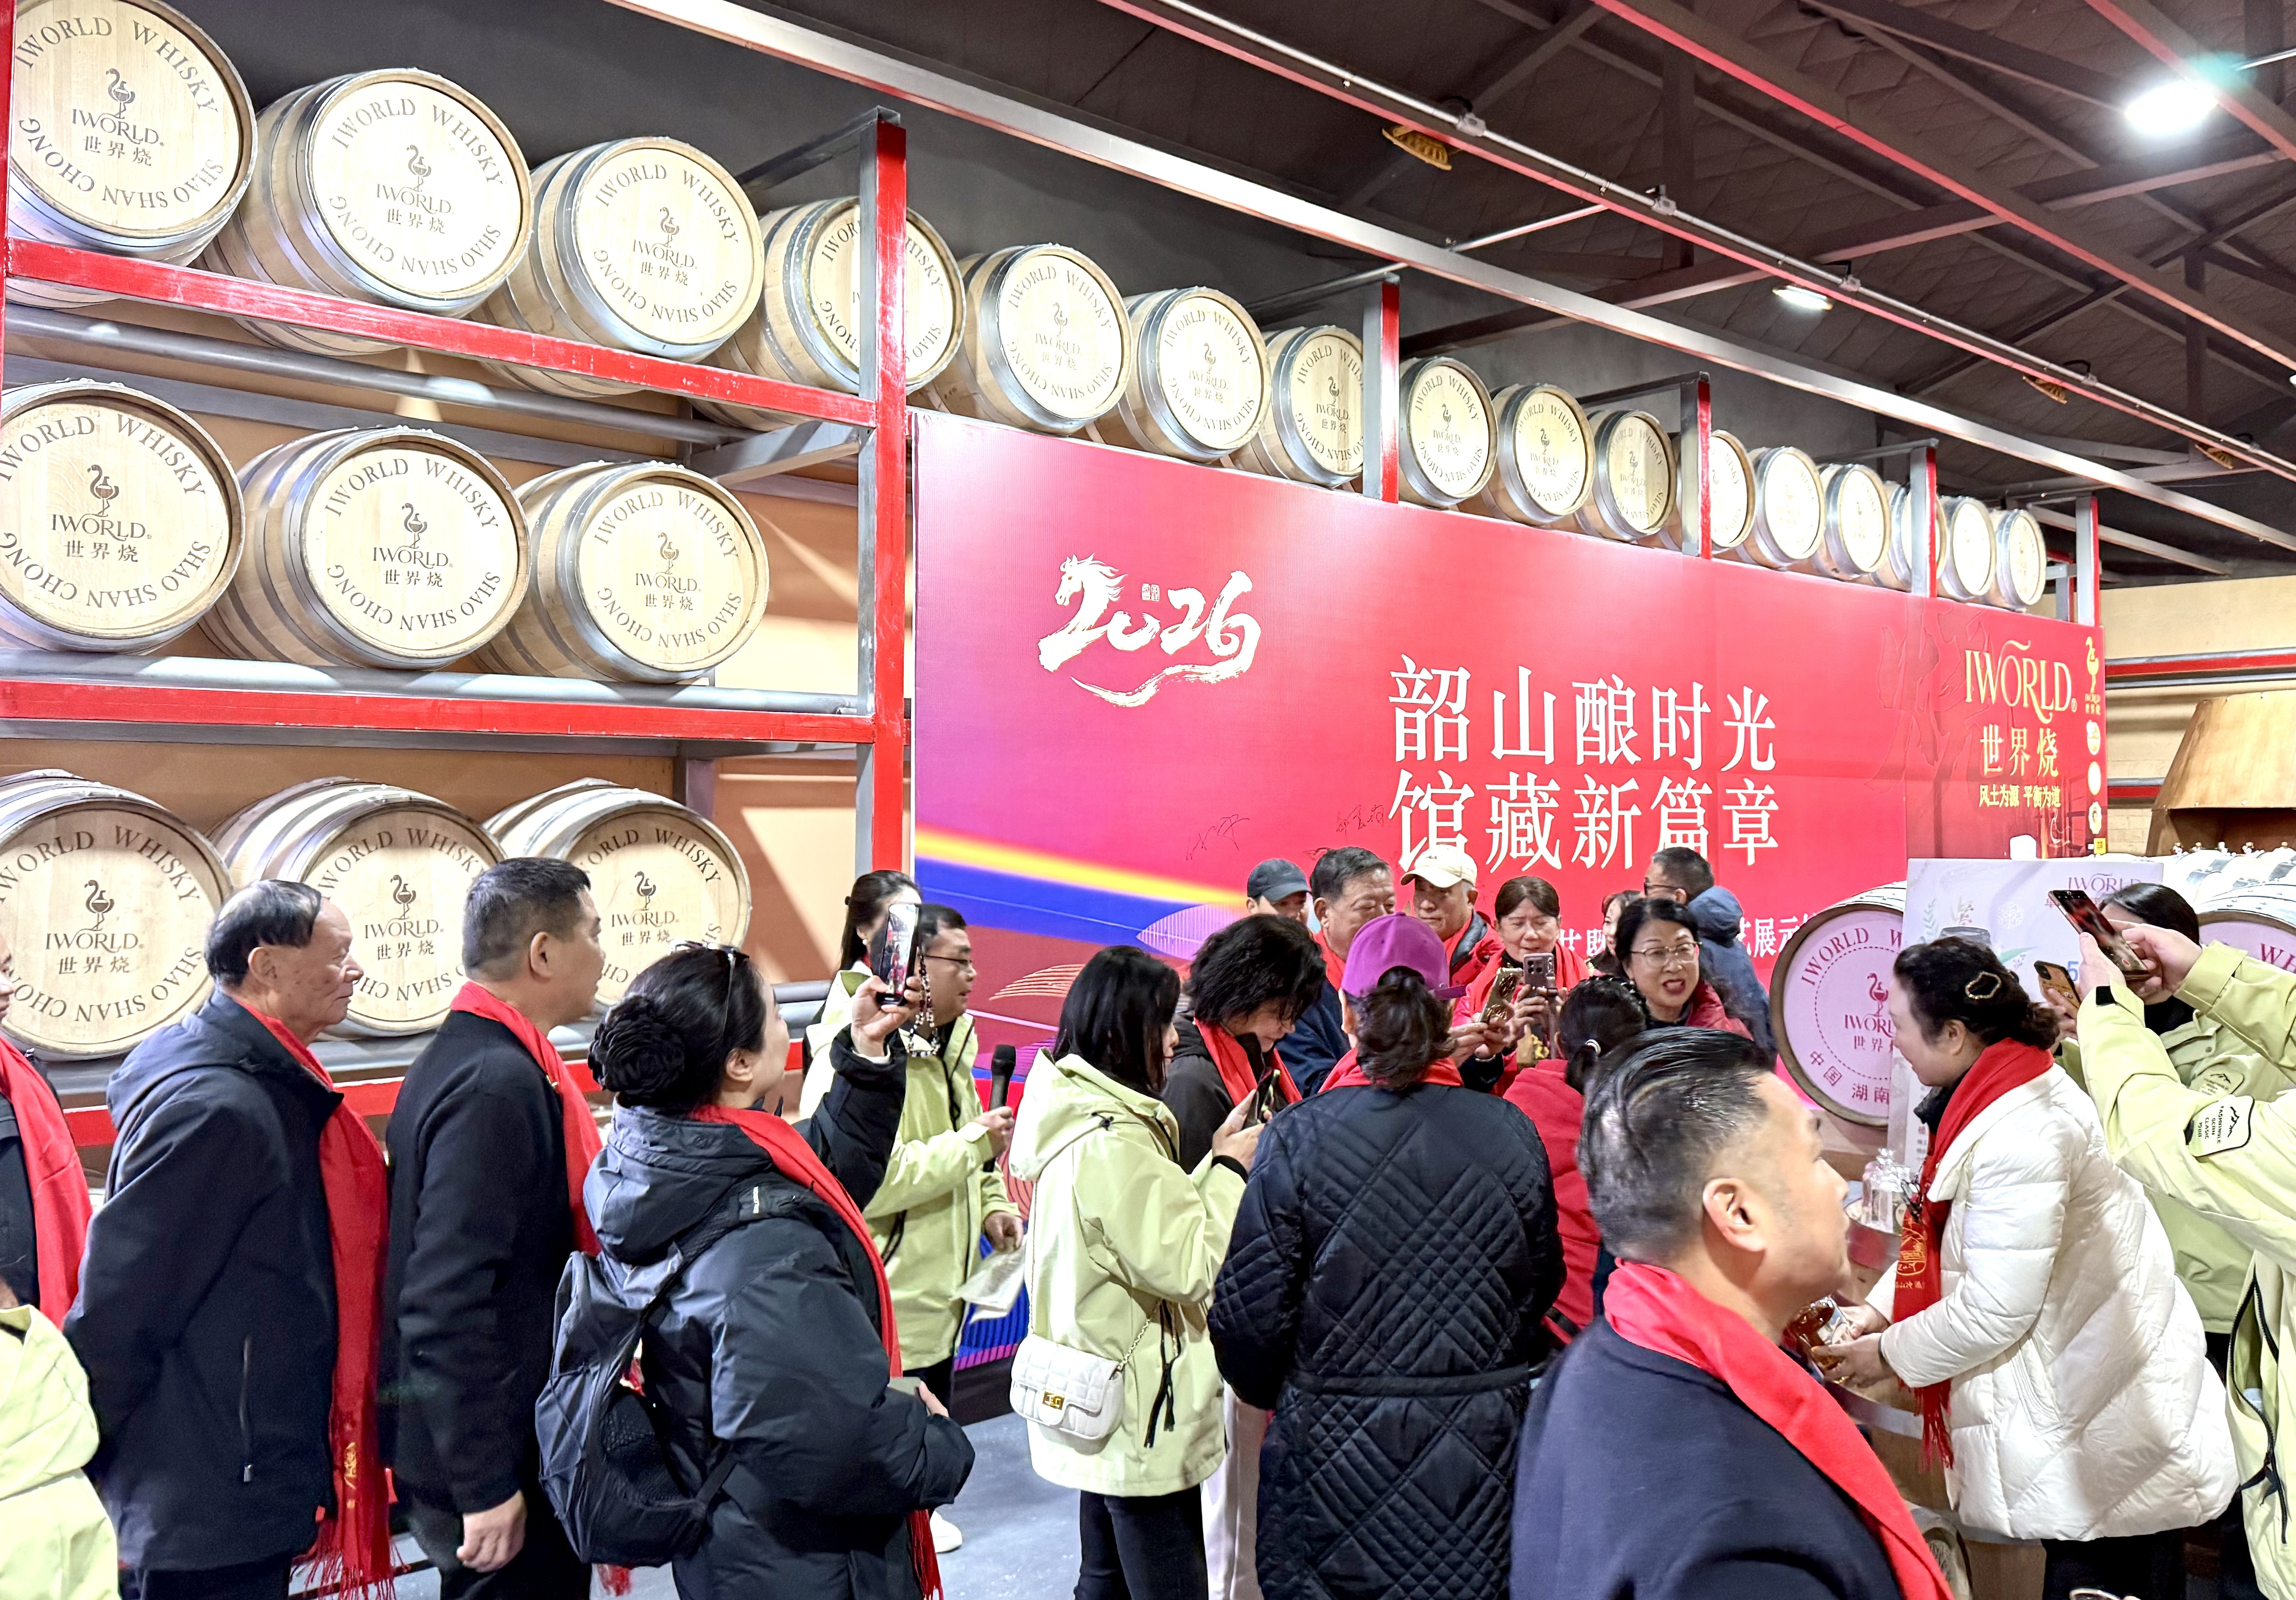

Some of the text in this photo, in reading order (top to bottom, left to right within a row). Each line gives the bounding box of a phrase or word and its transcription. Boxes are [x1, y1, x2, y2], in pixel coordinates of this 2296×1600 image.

[15, 17, 218, 113] IWORLD WHISKY
[20, 118, 223, 208] SHAO SHAN CHONG
[83, 136, 152, 166] 世界烧
[332, 99, 503, 185] IWORLD WHISKY
[388, 209, 445, 234] 世界烧
[595, 165, 738, 243] IWORLD WHISKY
[329, 195, 501, 275] SHAO SHAN CHONG
[822, 220, 943, 287] IWOR HISKY
[594, 249, 737, 322] SHAO SHAN CHONG
[641, 262, 688, 286] 世界烧
[1008, 266, 1112, 329] IWORLD WHISKY
[820, 301, 942, 357] SHAO HONG
[1164, 310, 1252, 365] IWORLD WHISKY
[1007, 341, 1112, 399] SHAO SHAN CHONG
[1195, 386, 1223, 404] 世界烧
[1297, 345, 1363, 390] IWORLD WHIS
[1168, 377, 1255, 430] SHAO SHAN CHONG
[1415, 375, 1479, 420] IWORLD WHISKY
[0, 414, 206, 496] IWORLD WHISKY
[1295, 413, 1324, 454] CHONG
[1327, 448, 1352, 460] SHAN
[325, 458, 499, 529] IWORLD WHISKY
[65, 540, 138, 563] 世界烧
[595, 490, 738, 558] IWORLD WHISKY
[0, 532, 211, 608] SHAO SHAN CHONG
[327, 564, 500, 630] SHAO SHAN CHONG
[384, 570, 443, 587] 世界烧
[597, 588, 741, 648] SHAO SHAN CHONG
[645, 594, 693, 611] 世界烧
[1038, 552, 1261, 708] 2026
[1389, 653, 1776, 772] 韶山酿时光
[1980, 724, 2059, 777] 世界烧
[1388, 769, 1778, 873] 馆藏新篇章
[1979, 784, 2061, 808] 风土为源 平衡为道
[115, 825, 200, 902] WHISKY
[318, 830, 393, 900] WORLD
[578, 828, 721, 884] ORLD WHISKY
[377, 941, 435, 961] 世界烧
[621, 929, 670, 946] 世界烧
[1800, 927, 1869, 987] IWORLD
[9, 947, 202, 1022] SHAO SHAN CHO
[57, 956, 131, 976] 世界烧
[397, 973, 452, 1001] SHAN
[1845, 1014, 1896, 1038] IWORL
[1854, 1035, 1893, 1054] 世界
